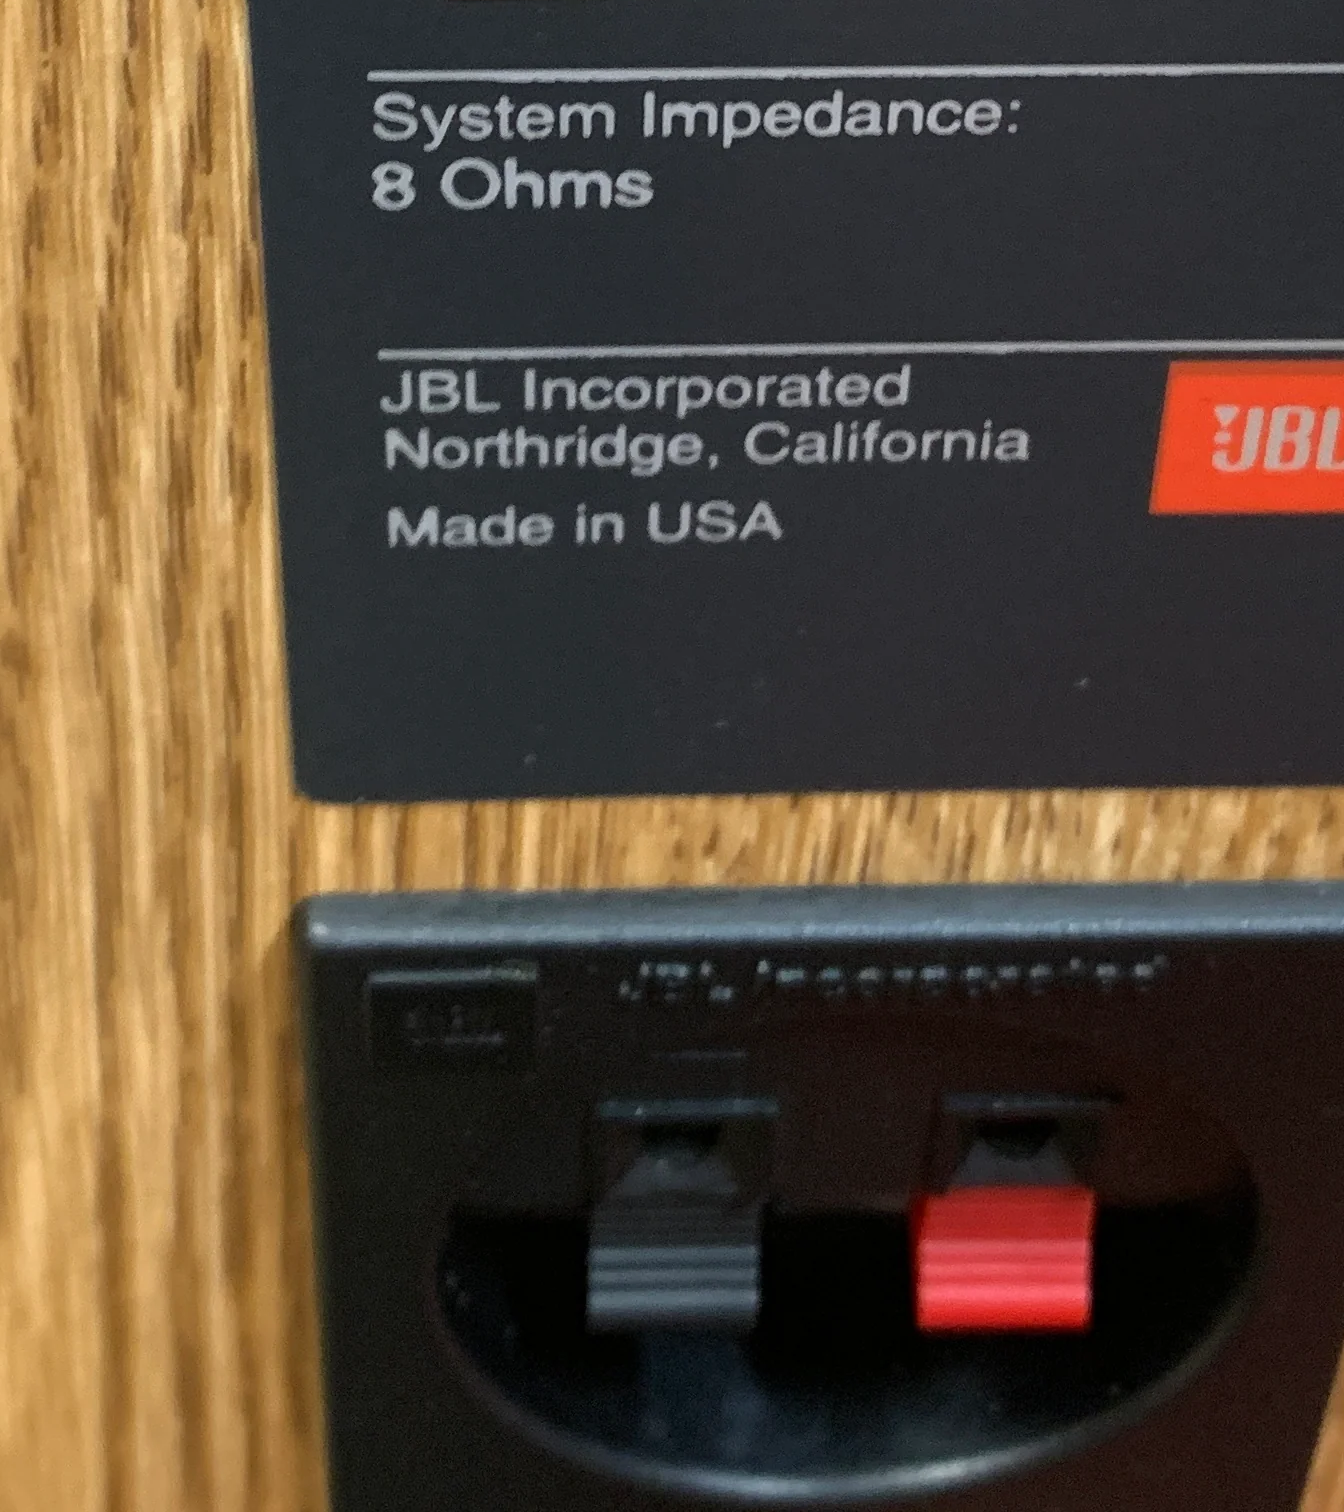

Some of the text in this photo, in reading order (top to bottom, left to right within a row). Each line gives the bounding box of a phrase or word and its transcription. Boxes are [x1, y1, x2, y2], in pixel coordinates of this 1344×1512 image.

[371, 89, 1021, 153] System Impedance:
[370, 156, 655, 212] 8 Ohms
[379, 363, 912, 418] JBL Incorporated
[384, 418, 1031, 477] Northridge, California
[387, 499, 784, 549] Made in USA
